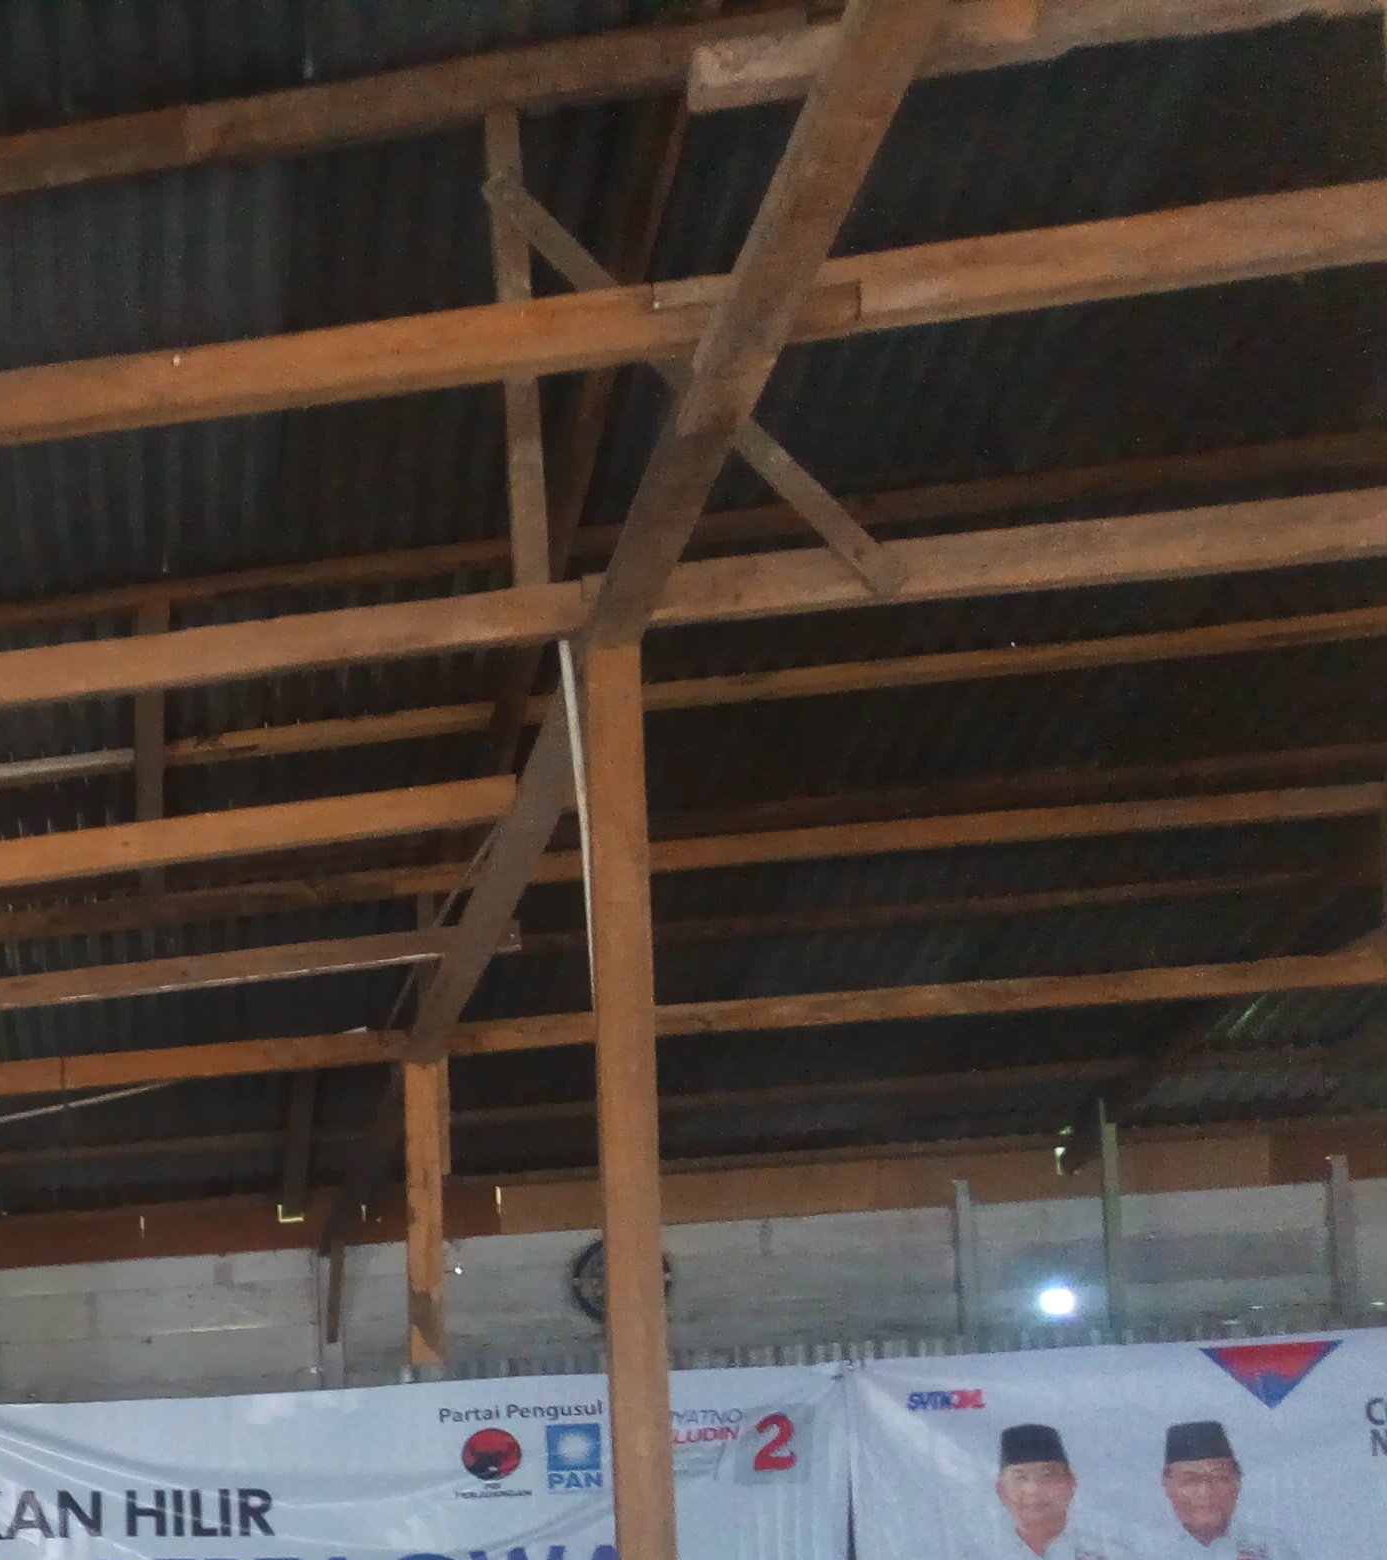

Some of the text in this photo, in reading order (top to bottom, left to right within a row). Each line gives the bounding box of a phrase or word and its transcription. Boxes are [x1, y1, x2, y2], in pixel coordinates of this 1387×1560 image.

[438, 1399, 604, 1424] Partai Pengusul
[754, 1412, 798, 1472] 2
[547, 1471, 604, 1490] PAN
[127, 1488, 276, 1538] HILIR
